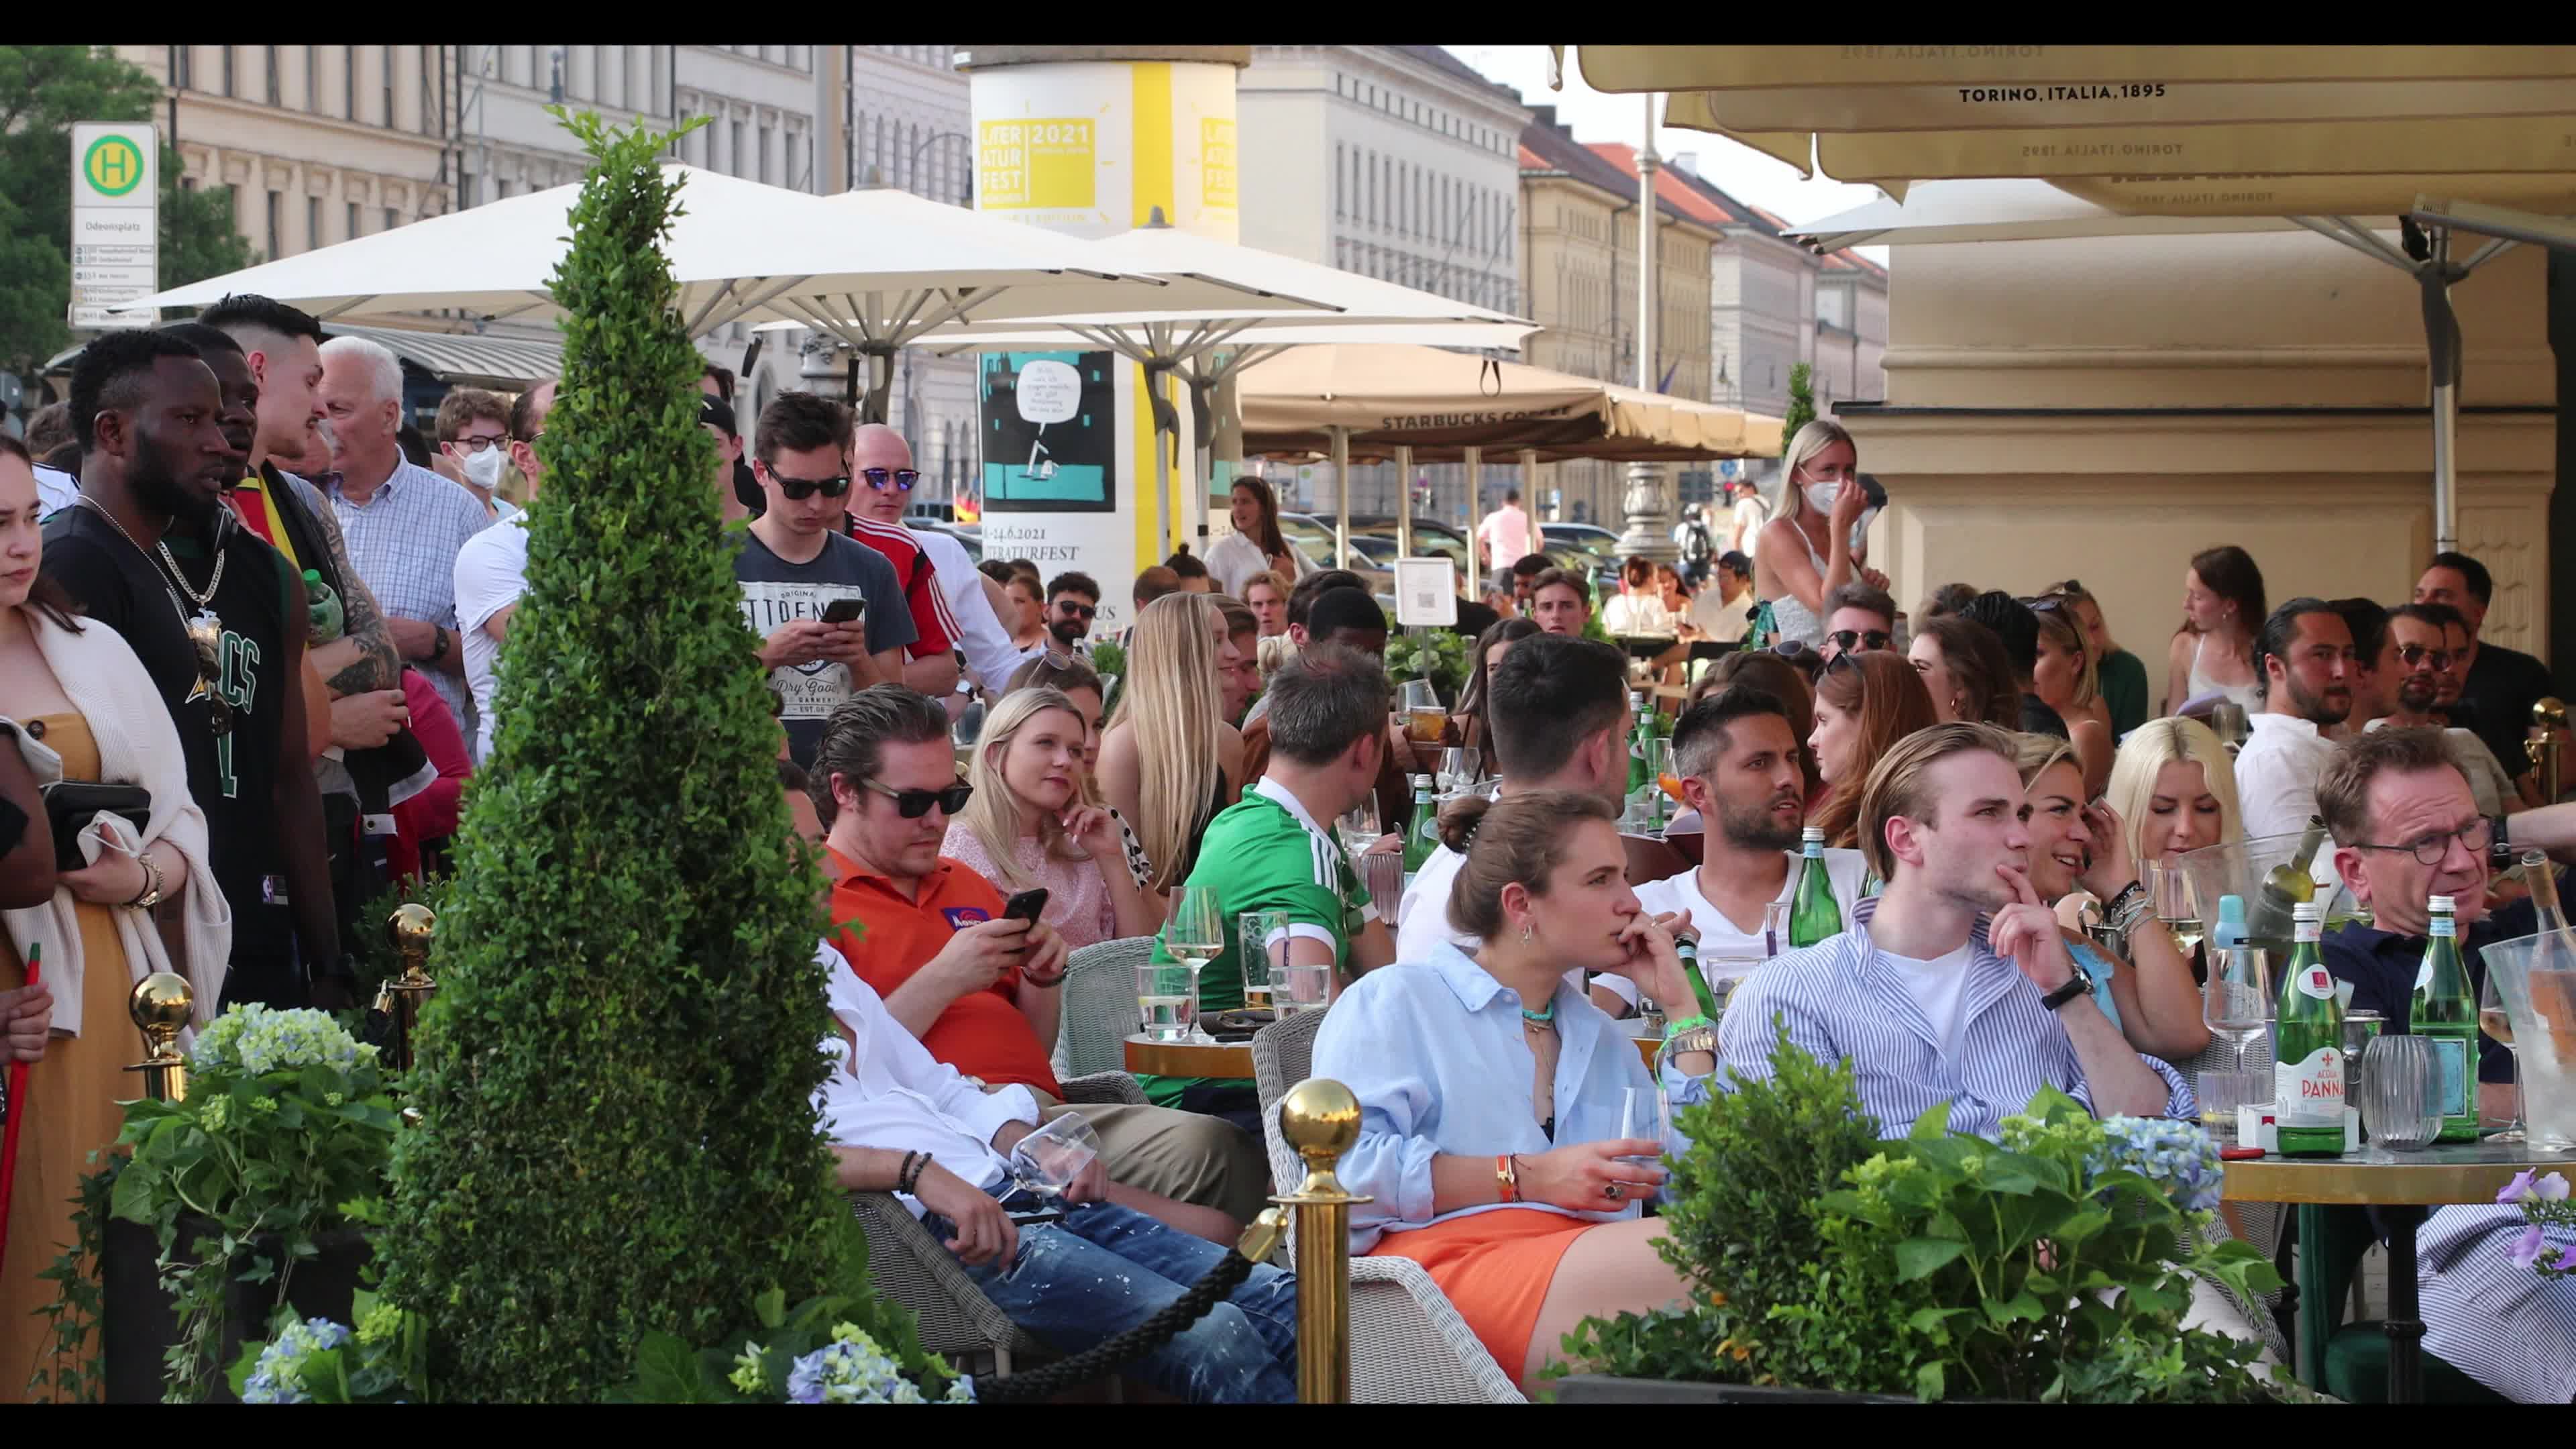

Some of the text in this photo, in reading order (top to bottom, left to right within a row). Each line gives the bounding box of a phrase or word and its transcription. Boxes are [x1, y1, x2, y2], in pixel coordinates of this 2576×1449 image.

[1032, 125, 1089, 143] 2021
[981, 148, 1022, 166] ATUR
[982, 170, 1023, 190] FEST
[86, 221, 140, 233] Odeonsplatz
[1382, 411, 1497, 430] STARBUCKS
[777, 680, 804, 696] Dry
